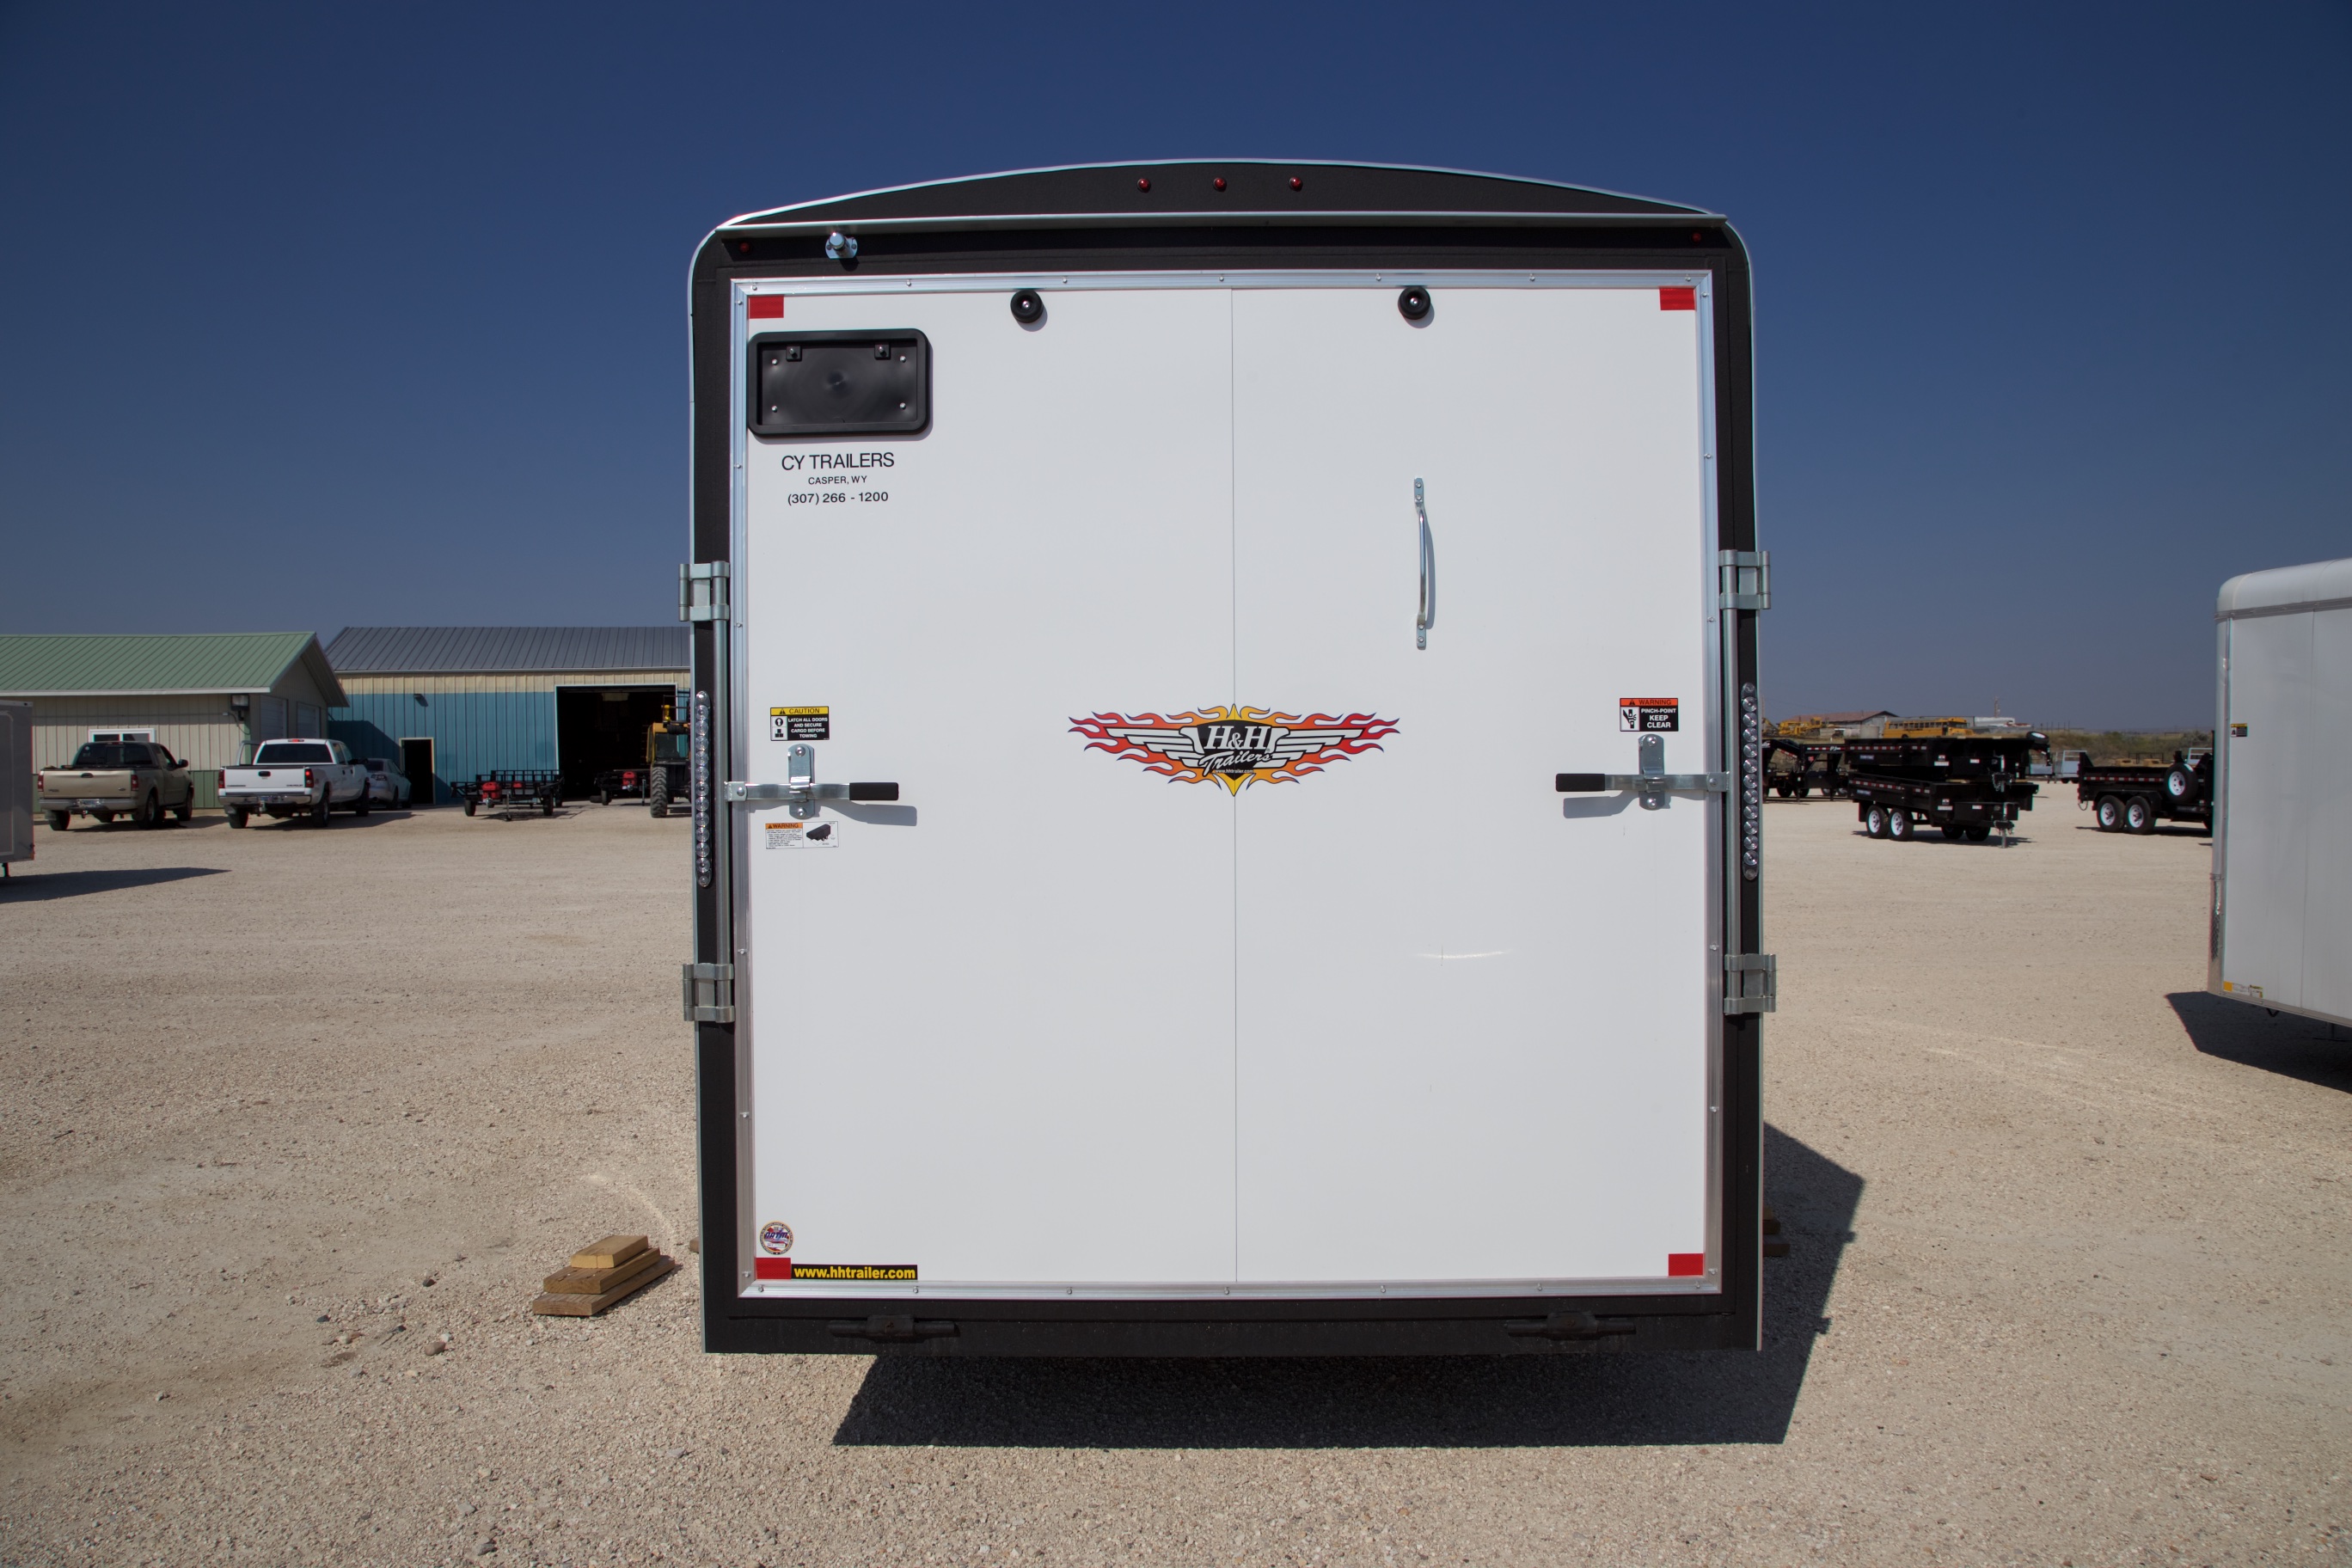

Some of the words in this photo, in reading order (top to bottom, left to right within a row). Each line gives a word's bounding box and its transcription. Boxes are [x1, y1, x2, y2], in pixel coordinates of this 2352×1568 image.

[781, 455, 805, 470] CY
[809, 452, 895, 469] TRAILERS
[808, 476, 849, 485] CASPER,
[787, 493, 819, 505] (307)
[823, 493, 846, 503] 266
[859, 492, 889, 502] 1200
[1204, 725, 1271, 750] H&H
[1198, 750, 1271, 777] Trailers
[793, 1265, 916, 1279] www.hhtrailer.com
